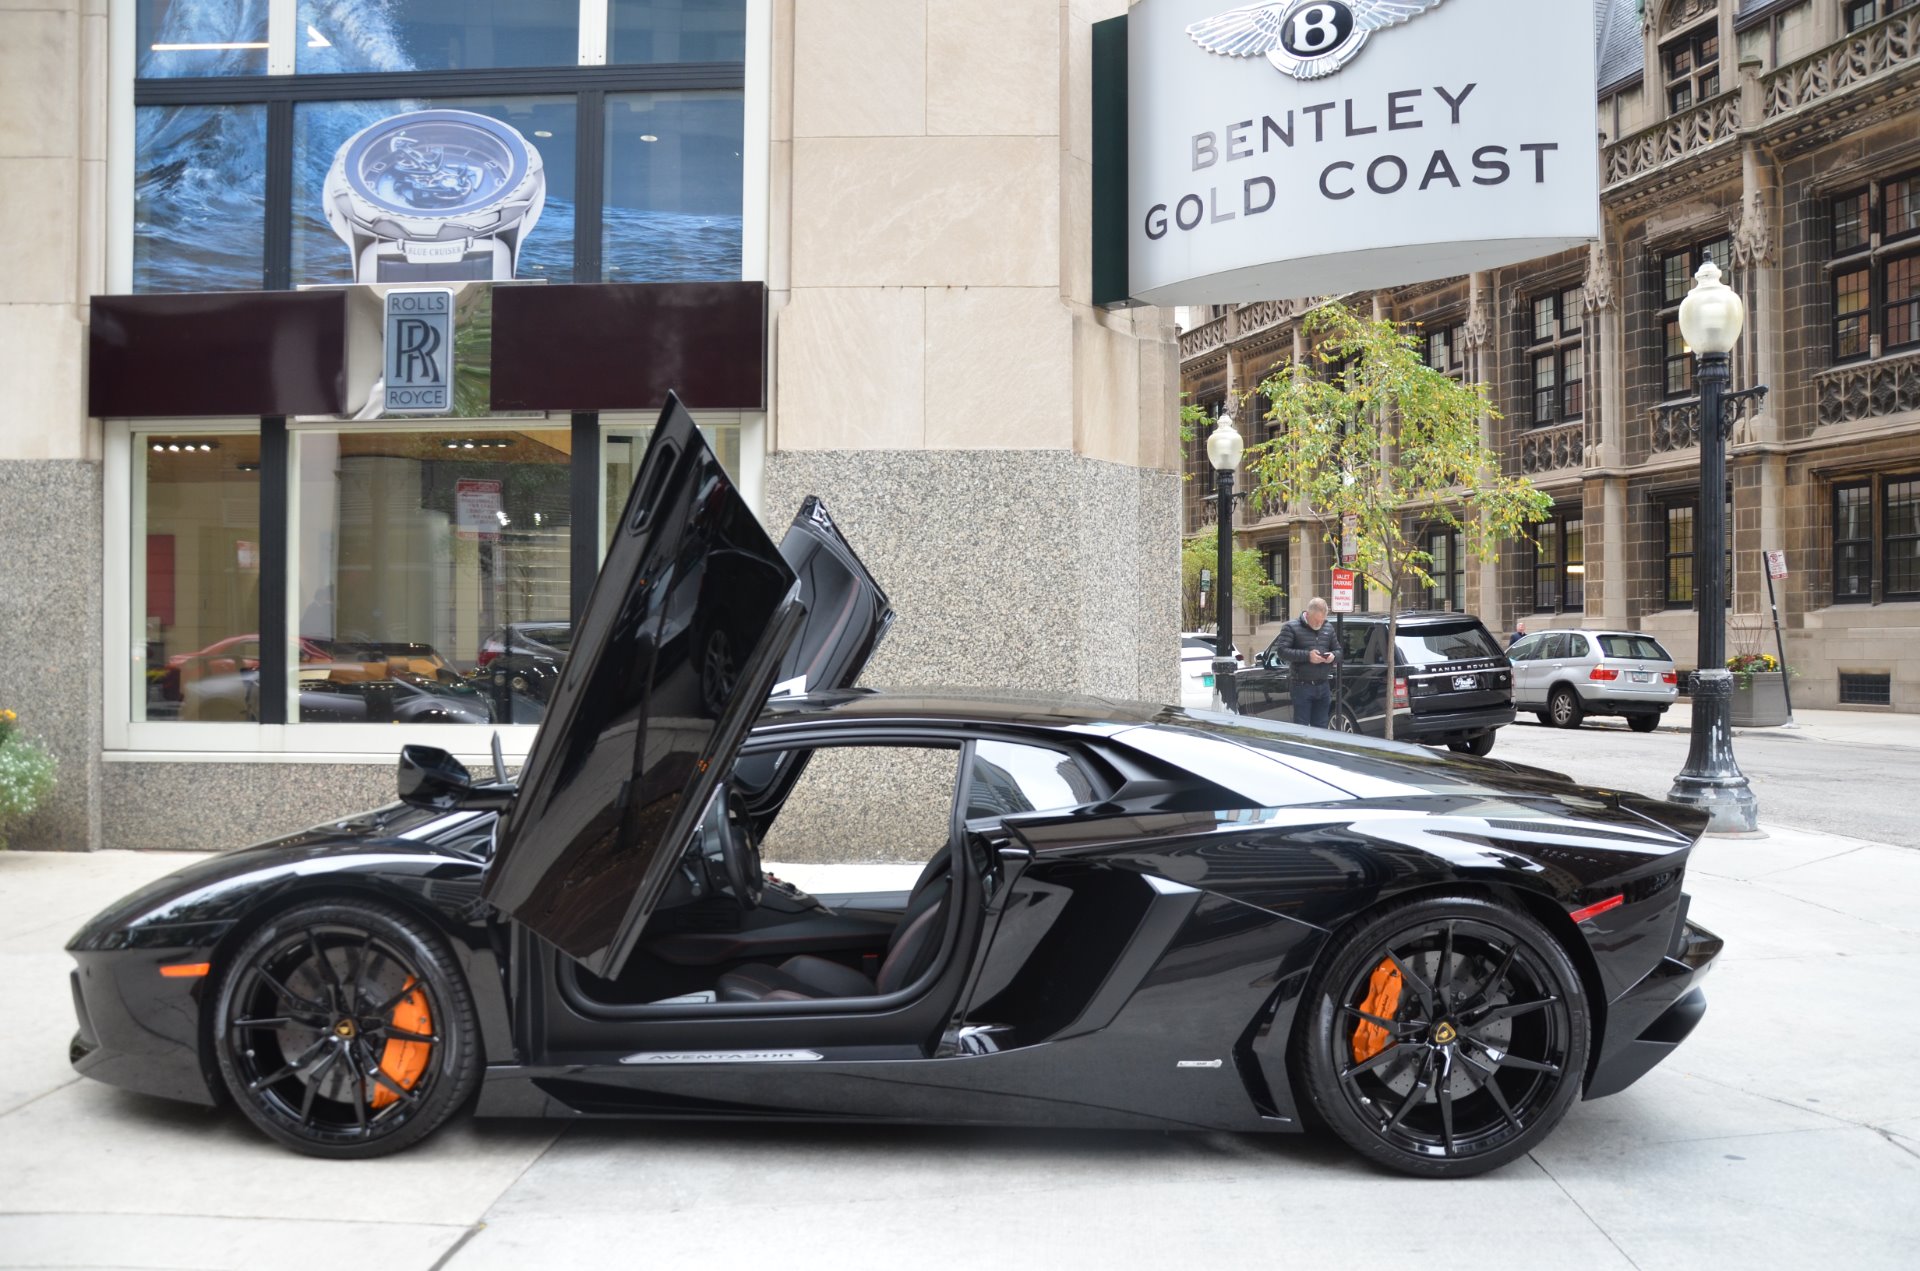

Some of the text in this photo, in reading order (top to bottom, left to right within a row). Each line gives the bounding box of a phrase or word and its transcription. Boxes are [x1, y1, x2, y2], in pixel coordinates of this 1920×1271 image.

[1190, 82, 1478, 172] BENTLEY
[1144, 142, 1558, 241] GOLD COAST
[408, 246, 462, 256] BLUE CRUISER
[391, 296, 444, 312] ROLLS
[390, 390, 443, 404] ROYCE
[1431, 662, 1495, 673] RANGE ROVER
